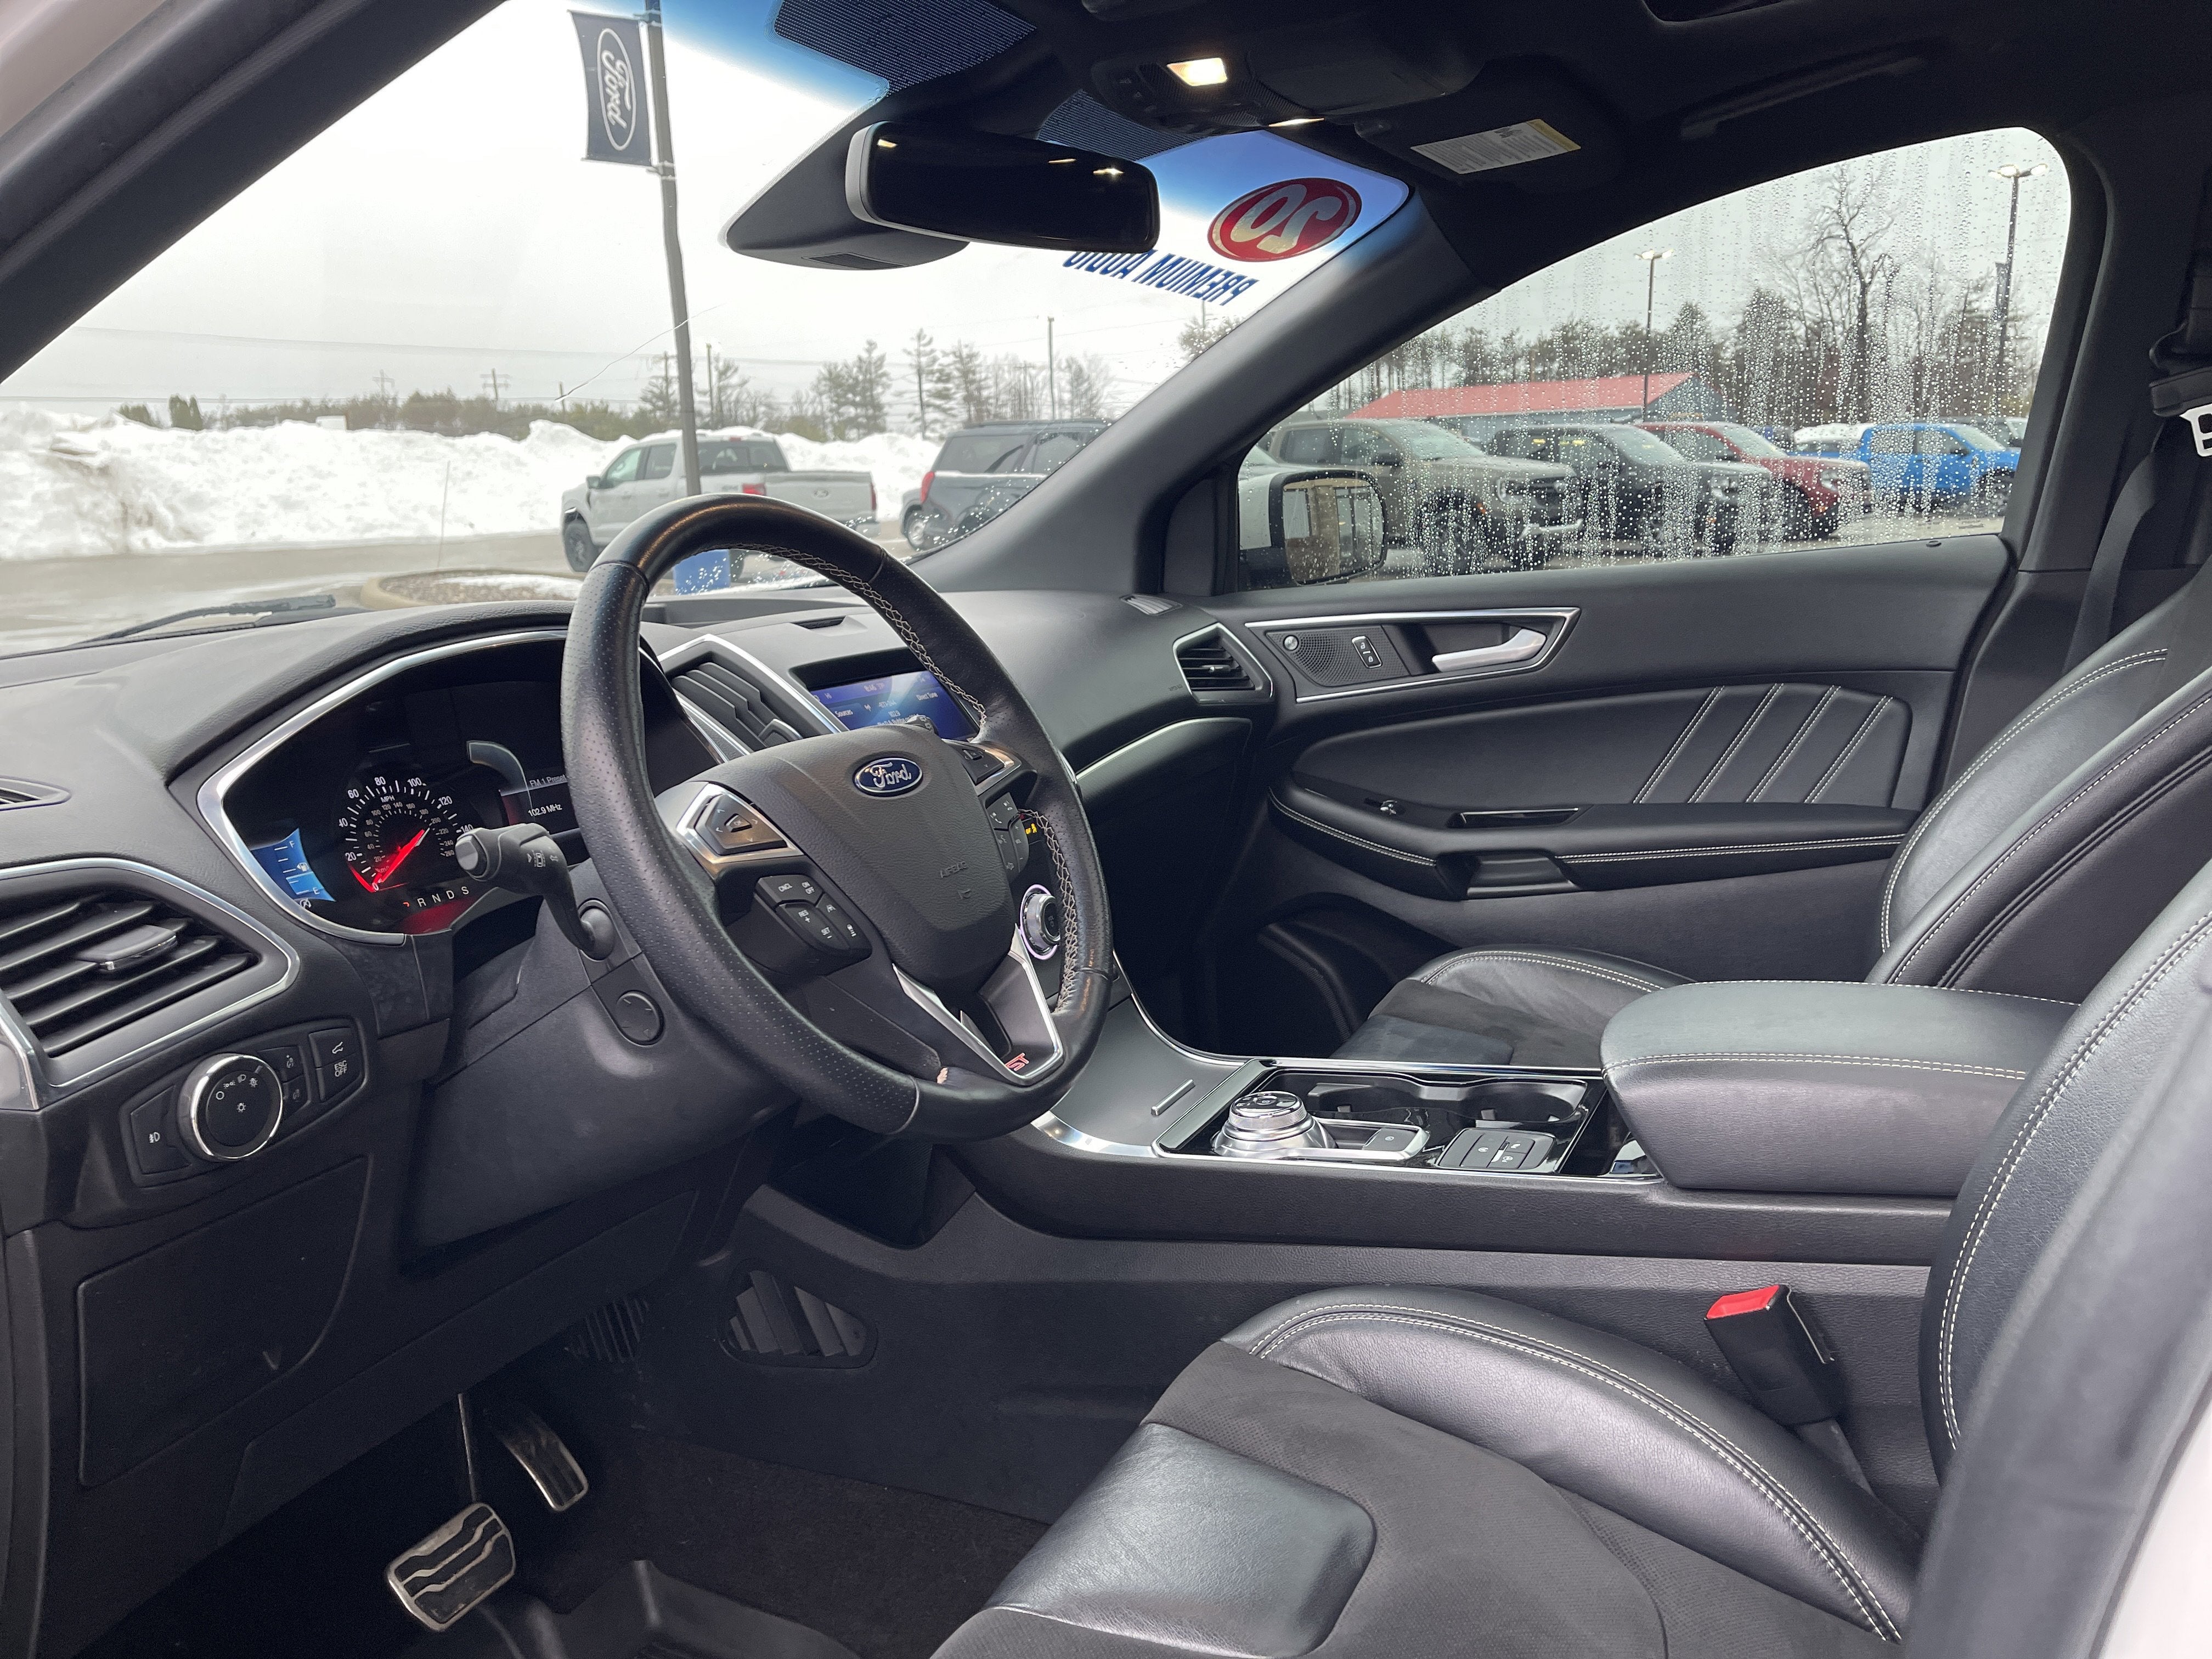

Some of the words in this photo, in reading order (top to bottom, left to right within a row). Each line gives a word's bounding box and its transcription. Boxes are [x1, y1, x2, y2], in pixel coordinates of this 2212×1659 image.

[602, 50, 631, 128] Ford
[870, 761, 912, 788] Ford
[374, 776, 386, 786] 80
[407, 777, 422, 787] 100
[347, 789, 359, 799] 60
[438, 795, 453, 806] 120
[528, 806, 546, 816] 102.9
[546, 803, 562, 813] MHz
[345, 851, 357, 861] 20
[312, 887, 320, 895] E
[372, 882, 379, 891] 0
[417, 898, 427, 907] R
[431, 893, 441, 903] N
[445, 890, 455, 899] D
[461, 886, 469, 895] S
[334, 1060, 347, 1070] ESC
[1005, 1052, 1029, 1071] ST
[335, 1066, 347, 1077] OFF
